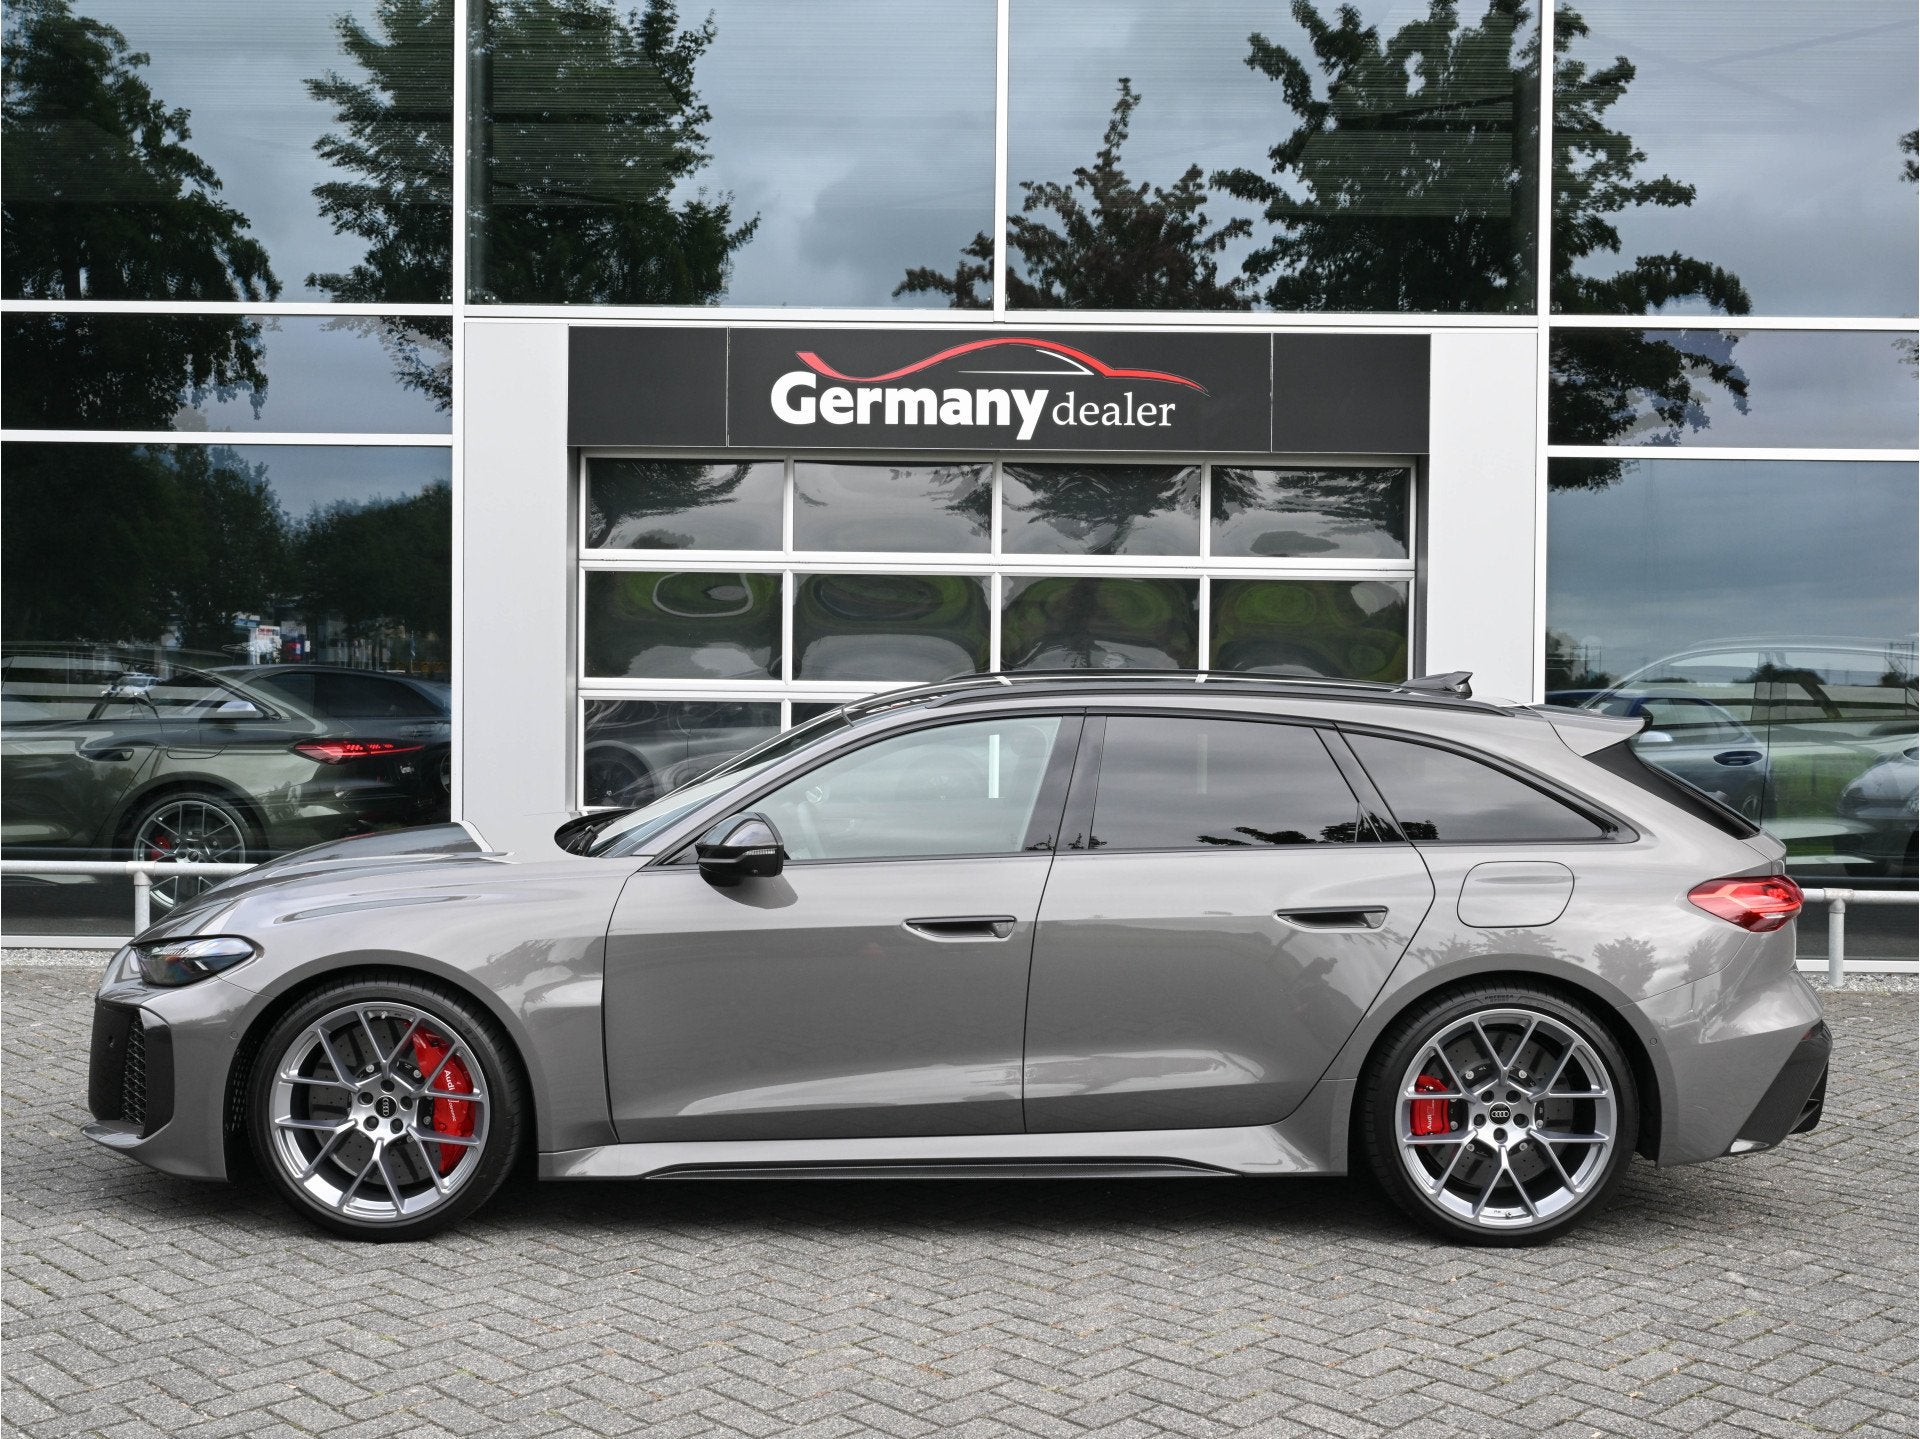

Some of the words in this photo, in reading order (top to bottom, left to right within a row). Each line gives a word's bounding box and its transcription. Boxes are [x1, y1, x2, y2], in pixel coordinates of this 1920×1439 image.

[770, 370, 1050, 441] Germany
[1052, 391, 1176, 427] dealer
[444, 1070, 455, 1091] Audi
